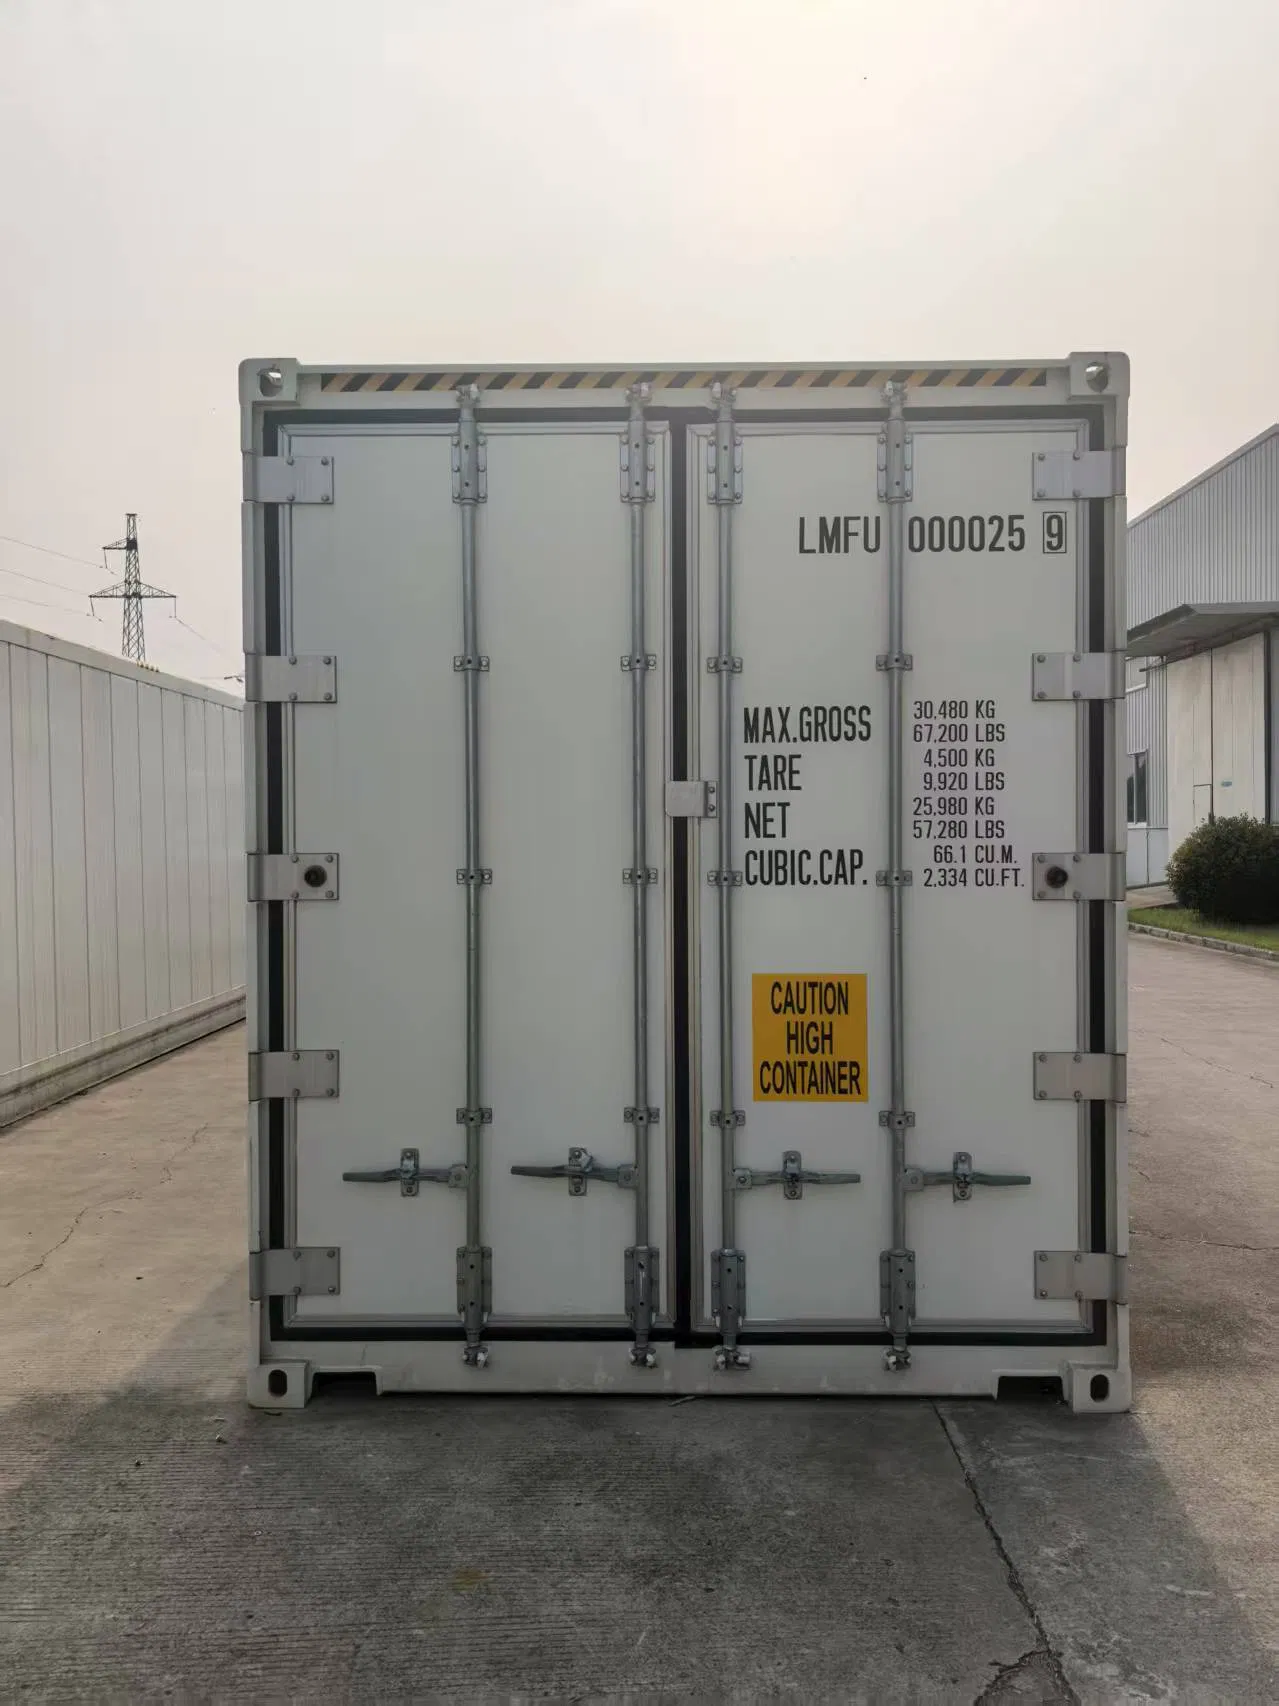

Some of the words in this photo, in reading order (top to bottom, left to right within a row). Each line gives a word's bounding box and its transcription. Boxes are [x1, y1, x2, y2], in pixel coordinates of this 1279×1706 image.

[799, 516, 880, 553] LMFU
[908, 515, 1025, 552] 000025
[1047, 515, 1063, 551] 9
[914, 701, 968, 719] 30,480
[976, 700, 995, 718] KG
[744, 705, 871, 743] MAX.GROSS
[914, 724, 968, 743] 67,200
[976, 724, 1005, 742] LBS
[924, 748, 967, 768] 4,500
[976, 748, 994, 767] KG
[744, 754, 802, 791] TARE
[924, 772, 967, 791] 9,920
[975, 772, 1004, 790] LBS
[745, 802, 790, 838] NET
[913, 797, 967, 816] 25,980
[975, 797, 994, 815] KG
[913, 820, 967, 839] 57,280
[975, 820, 1004, 838] LBS
[745, 849, 867, 886] CUBIC.CAP.
[934, 845, 965, 863] 66.1
[975, 845, 1016, 863] CU.M.
[975, 868, 1024, 887] CU.FT.
[771, 981, 848, 1015] CAUTION
[787, 1021, 833, 1055] HIGH
[760, 1061, 861, 1095] CONTAINER
